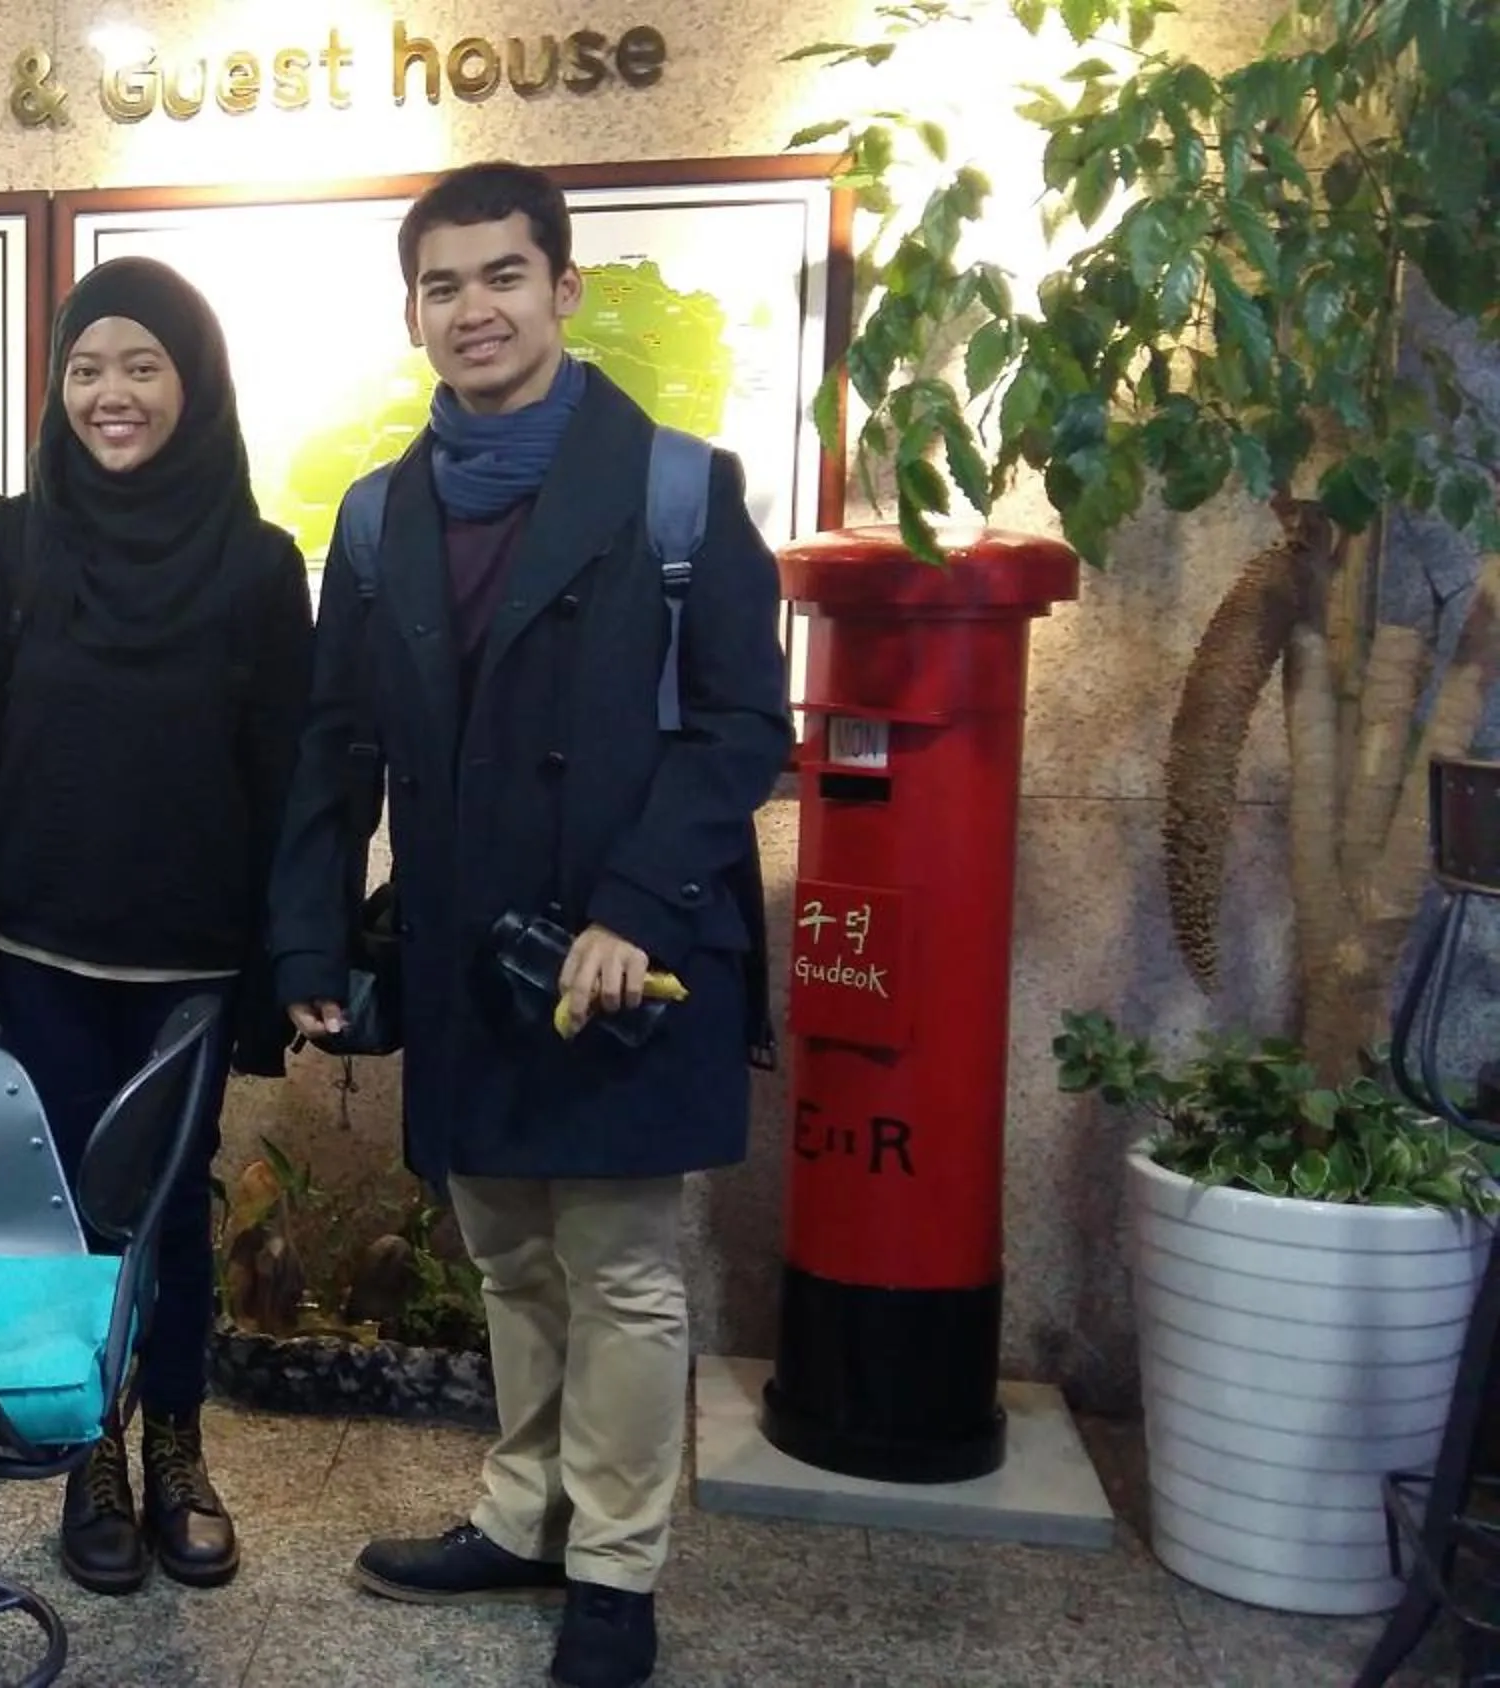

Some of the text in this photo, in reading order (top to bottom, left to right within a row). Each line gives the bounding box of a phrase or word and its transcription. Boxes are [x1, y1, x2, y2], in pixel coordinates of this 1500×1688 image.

[10, 47, 71, 130] &
[99, 28, 354, 124] Guest
[391, 19, 668, 108] house
[798, 901, 872, 955] 구덕
